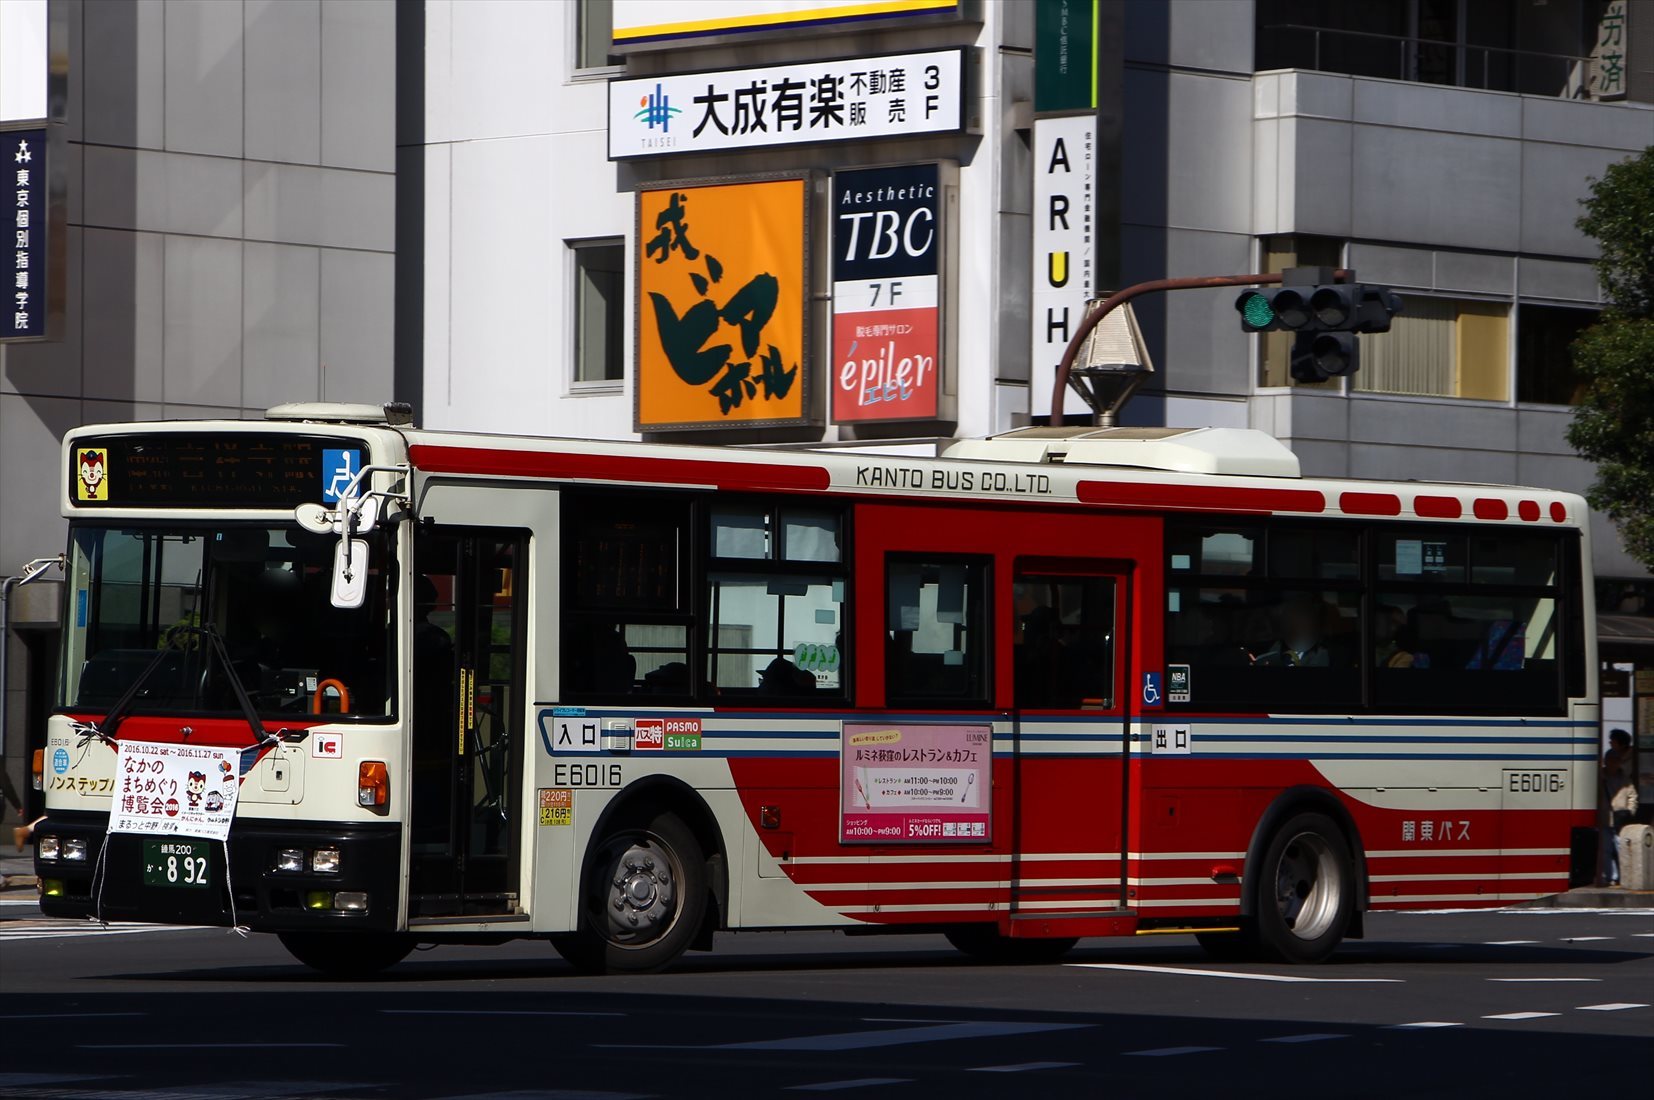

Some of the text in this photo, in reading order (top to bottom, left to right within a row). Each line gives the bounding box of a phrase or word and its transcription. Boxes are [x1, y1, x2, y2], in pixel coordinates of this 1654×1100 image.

[849, 67, 906, 97] 不動産
[692, 73, 845, 138] 大成有楽
[641, 136, 677, 148] TAISEI
[842, 183, 934, 205] Aesthetic
[840, 207, 934, 261] TBC
[14, 169, 30, 329] 東京個別指導学院
[855, 324, 913, 338] 脱毛専門サロン
[840, 340, 933, 406] épiler
[856, 465, 923, 488] KANTO
[931, 469, 974, 491] BUS
[1171, 672, 1186, 682] NBA
[558, 723, 596, 745] 入口
[636, 725, 663, 744] バス特
[666, 721, 699, 732] PASMO
[51, 738, 69, 746] E6016
[667, 736, 698, 747] Suica
[966, 733, 988, 742] LUMINE
[1155, 730, 1186, 749] 出口
[124, 744, 158, 756] 2016.10.22
[159, 748, 169, 756] sat
[177, 748, 211, 759] 2016.11.27
[212, 751, 224, 760] sun
[123, 755, 165, 775] なかの
[554, 764, 622, 786] E6016
[1509, 773, 1560, 792] E6016
[122, 775, 178, 797] まちめぐり
[120, 794, 165, 815] 博覧会
[545, 791, 567, 802] 220円
[165, 803, 179, 812] 2016
[545, 808, 567, 818] 216円
[118, 819, 159, 830] まるっと中野
[1402, 820, 1471, 842] 関東バス
